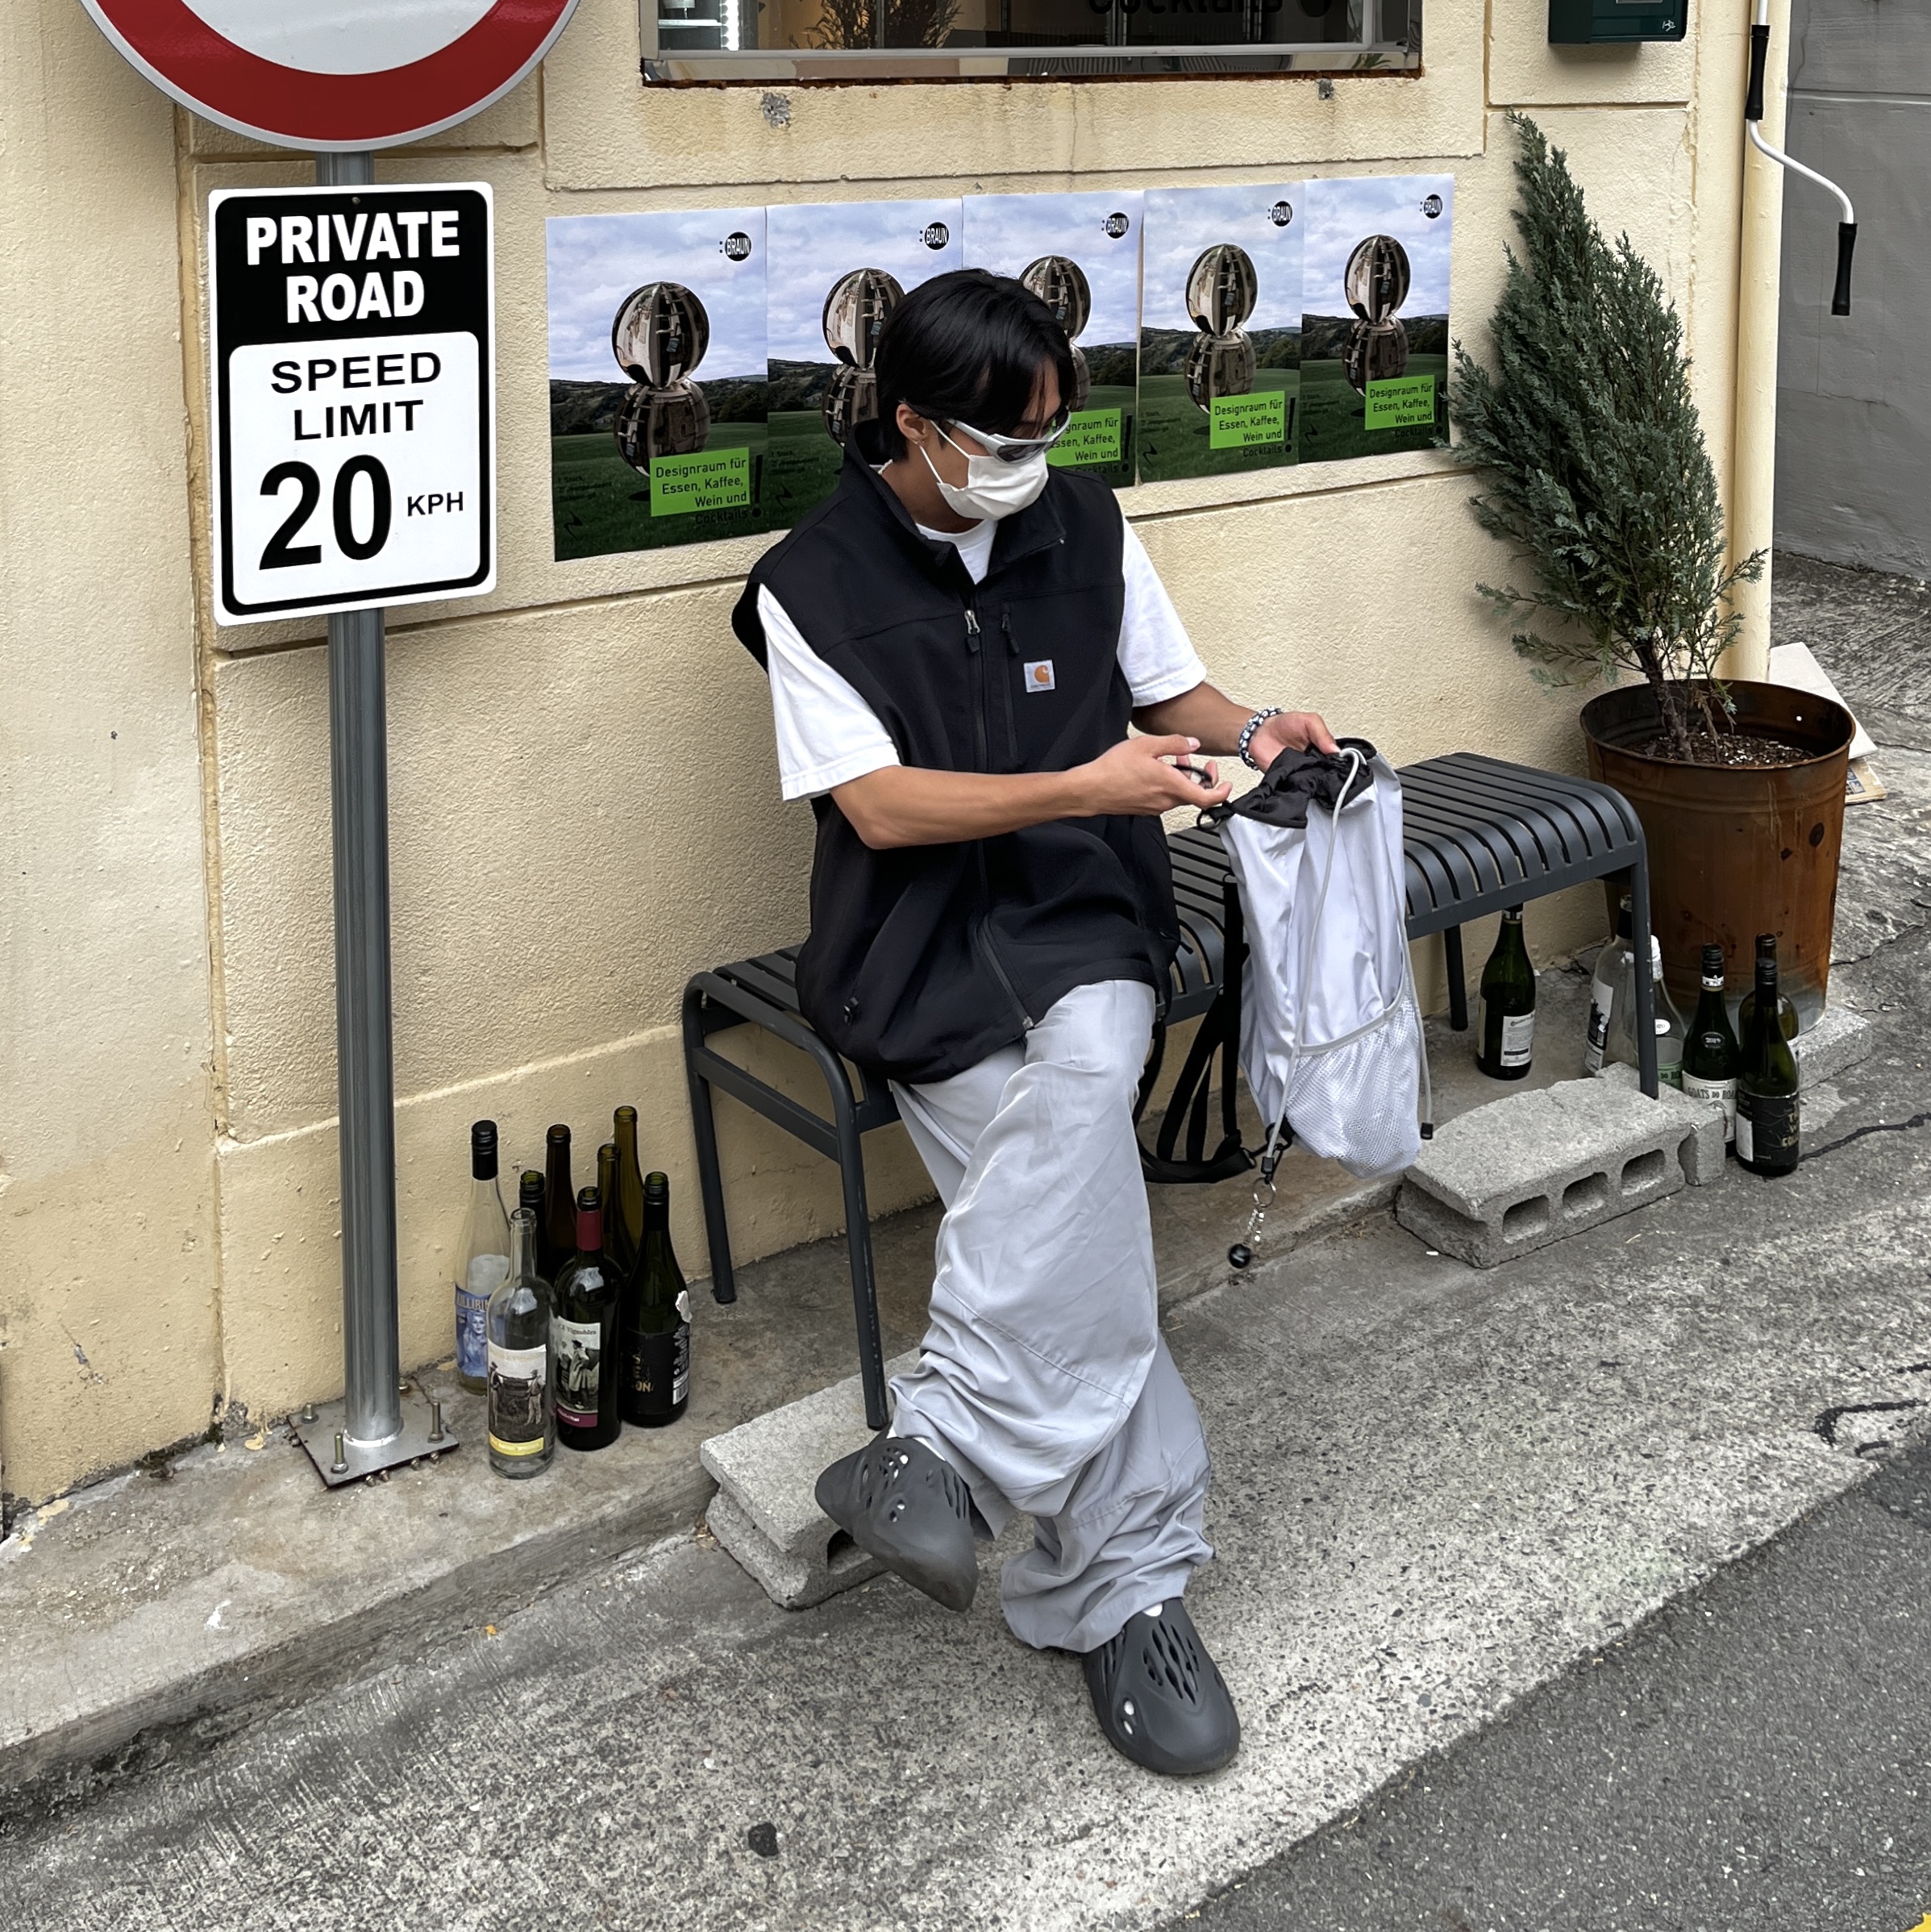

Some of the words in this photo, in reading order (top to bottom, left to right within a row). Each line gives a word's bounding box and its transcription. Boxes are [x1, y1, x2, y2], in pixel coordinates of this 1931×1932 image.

[247, 210, 460, 265] PRIVATE
[286, 270, 425, 323] ROAD
[271, 352, 441, 393] SPEED
[1369, 386, 1418, 398] Designraum
[1421, 383, 1433, 393] für
[1214, 402, 1267, 416] Designraum
[1270, 398, 1283, 410] für
[1373, 402, 1400, 412] Essen,
[1402, 398, 1430, 410] Kaffee,
[294, 399, 423, 440] LIMIT
[1066, 420, 1102, 434] gnraum
[1105, 417, 1118, 427] für
[1219, 420, 1248, 430] Essen,
[1250, 415, 1280, 427] Kaffee,
[1395, 413, 1415, 423] Wein
[1417, 411, 1433, 422] und
[1051, 438, 1080, 448] ssen,
[1084, 433, 1115, 446] Kaffee,
[1243, 431, 1263, 443] Wein
[1266, 428, 1282, 439] und
[1075, 450, 1097, 462] Wein
[1101, 448, 1118, 459] und
[1242, 444, 1283, 457] Cocktails
[656, 462, 726, 477] Designraum
[730, 457, 747, 469] für
[662, 482, 701, 495] Essen,
[705, 476, 743, 489] Kaffee,
[695, 494, 722, 508] Wein
[726, 491, 747, 503] und
[259, 454, 392, 570] 20
[407, 491, 464, 517] KPH
[695, 508, 748, 524] Cocktails
